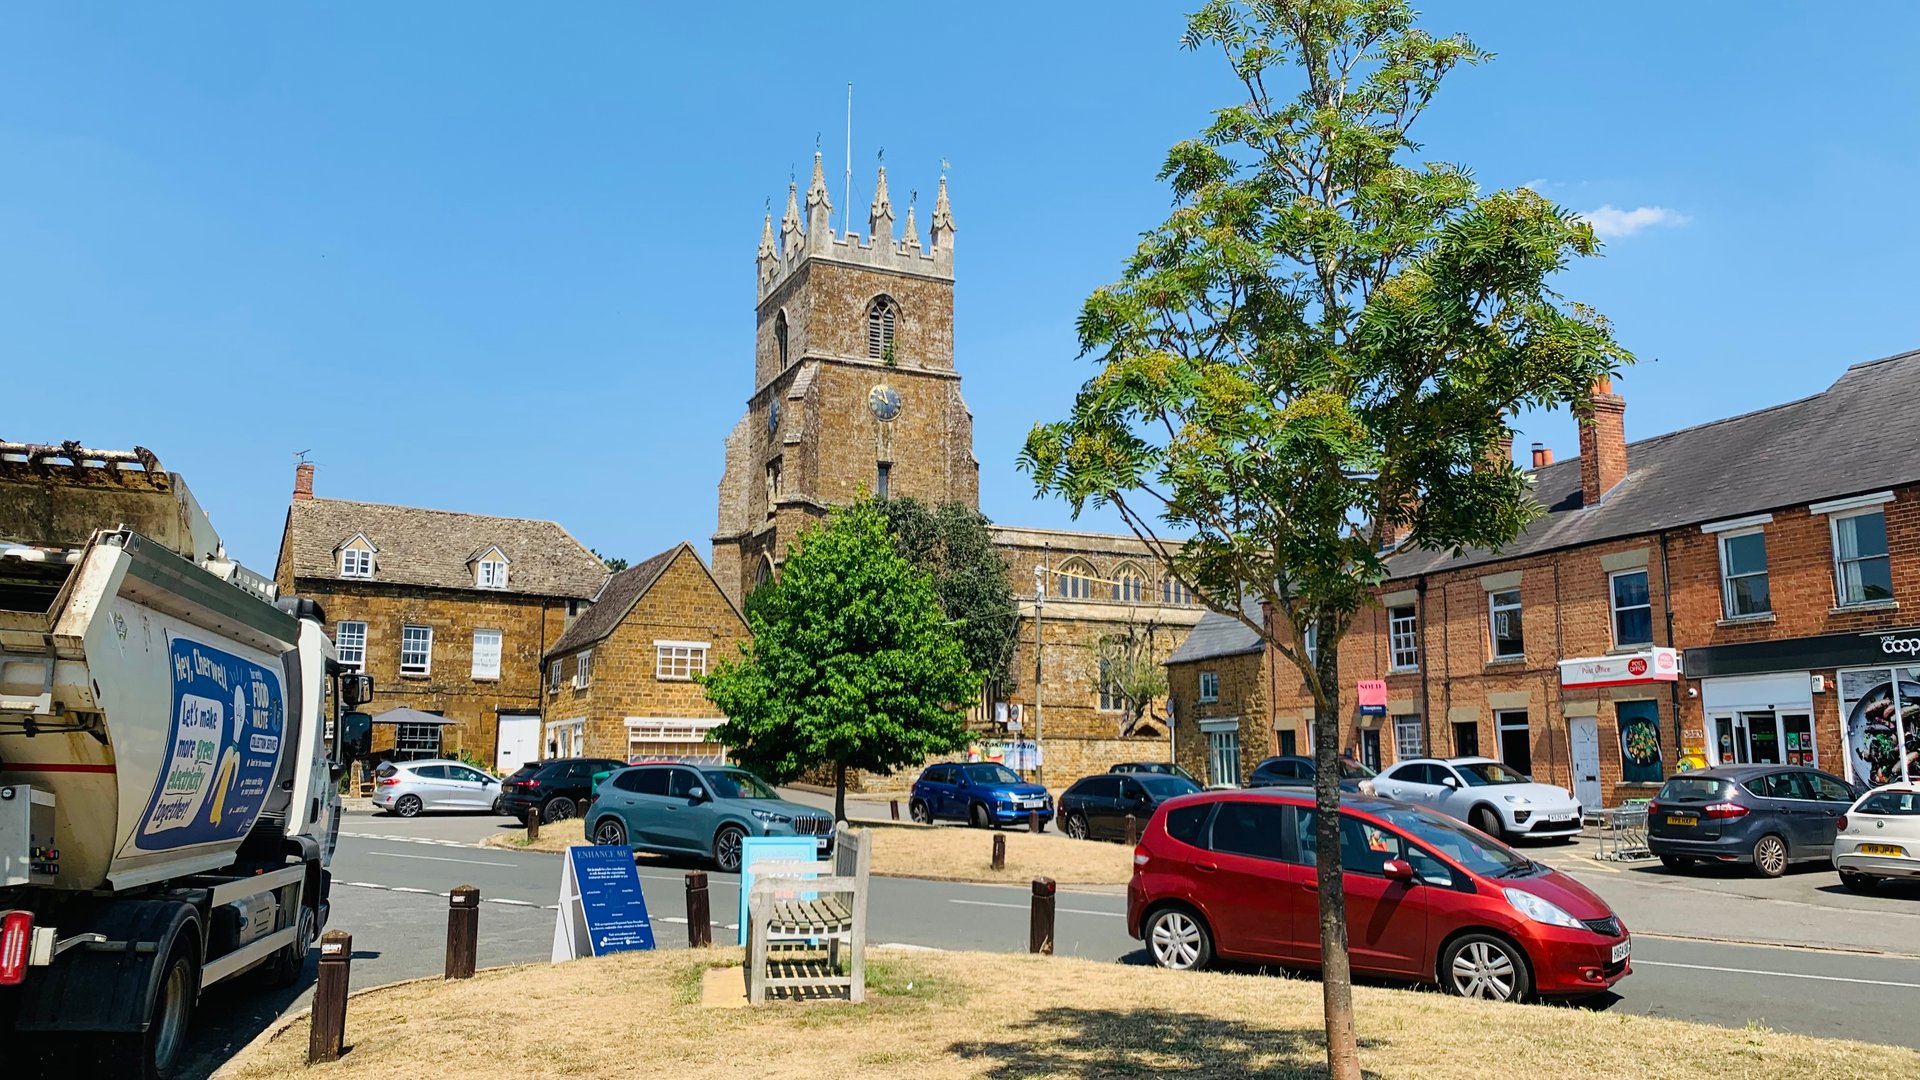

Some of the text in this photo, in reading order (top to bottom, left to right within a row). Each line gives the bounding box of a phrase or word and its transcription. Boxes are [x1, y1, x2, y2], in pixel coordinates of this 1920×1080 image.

[1880, 635, 1895, 643] your
[1882, 638, 1920, 656] coop
[174, 648, 228, 693] Hey, Cherwell
[1582, 664, 1610, 675] Post Office
[1629, 665, 1646, 673] OFFICE
[252, 681, 269, 708] FOOD
[182, 700, 218, 730] Let's make
[252, 708, 269, 730] WASTE
[176, 738, 215, 765] more green
[166, 764, 206, 795] electricity
[152, 797, 193, 829] together!
[577, 849, 629, 859] ENHANCE ME
